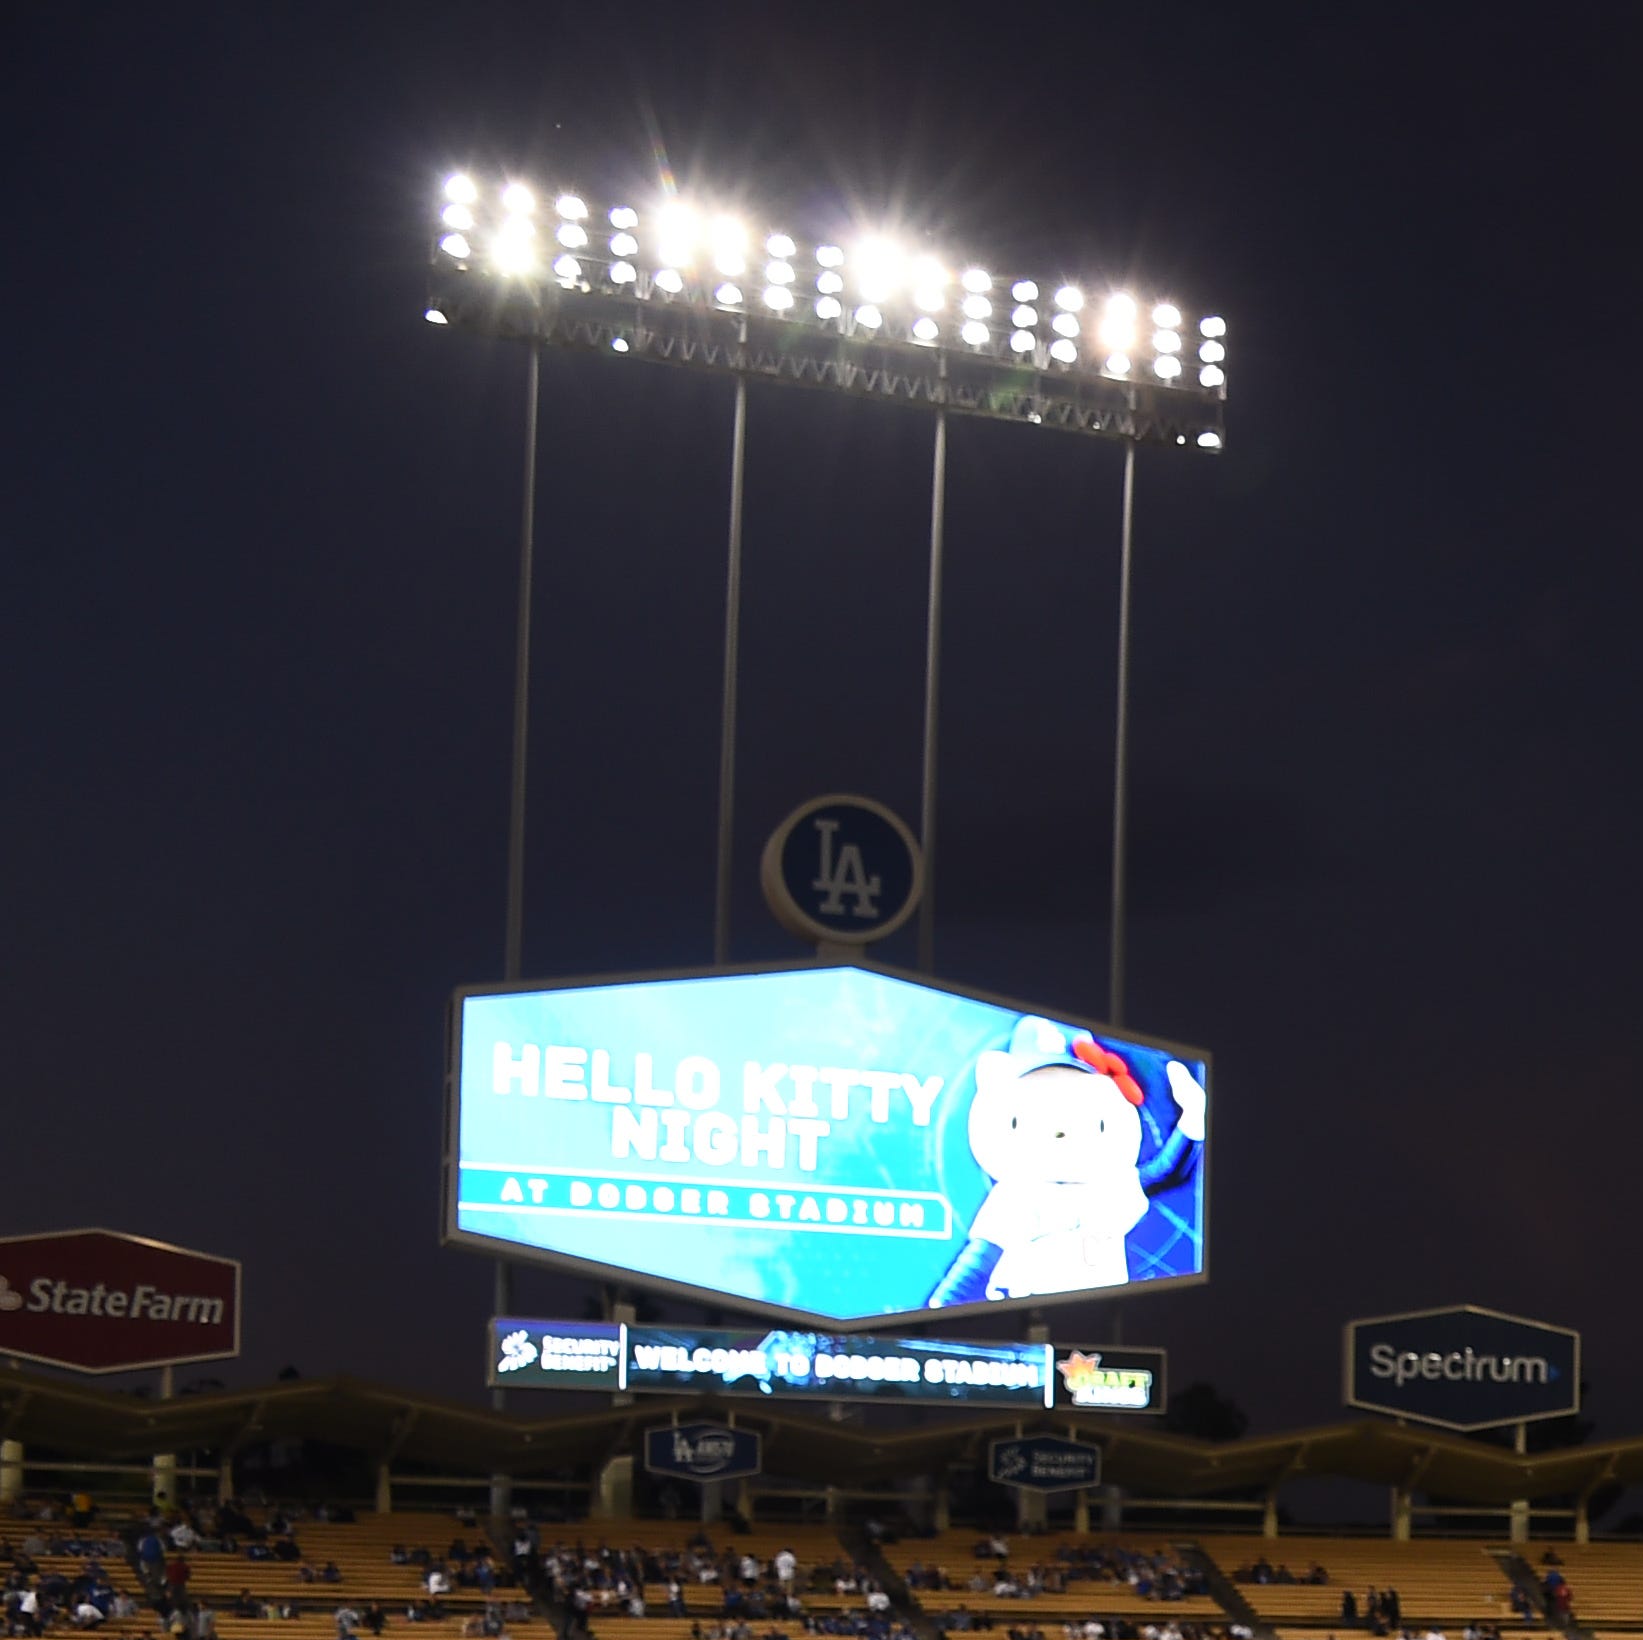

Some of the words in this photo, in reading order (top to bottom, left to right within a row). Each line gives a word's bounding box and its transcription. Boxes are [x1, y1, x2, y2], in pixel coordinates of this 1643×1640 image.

[812, 819, 881, 918] LA
[493, 1041, 720, 1110] HELLO
[743, 1061, 945, 1126] KITTY
[611, 1106, 831, 1171] NIGHT
[500, 1177, 548, 1203] AT
[1369, 1344, 1548, 1386] Spectrum
